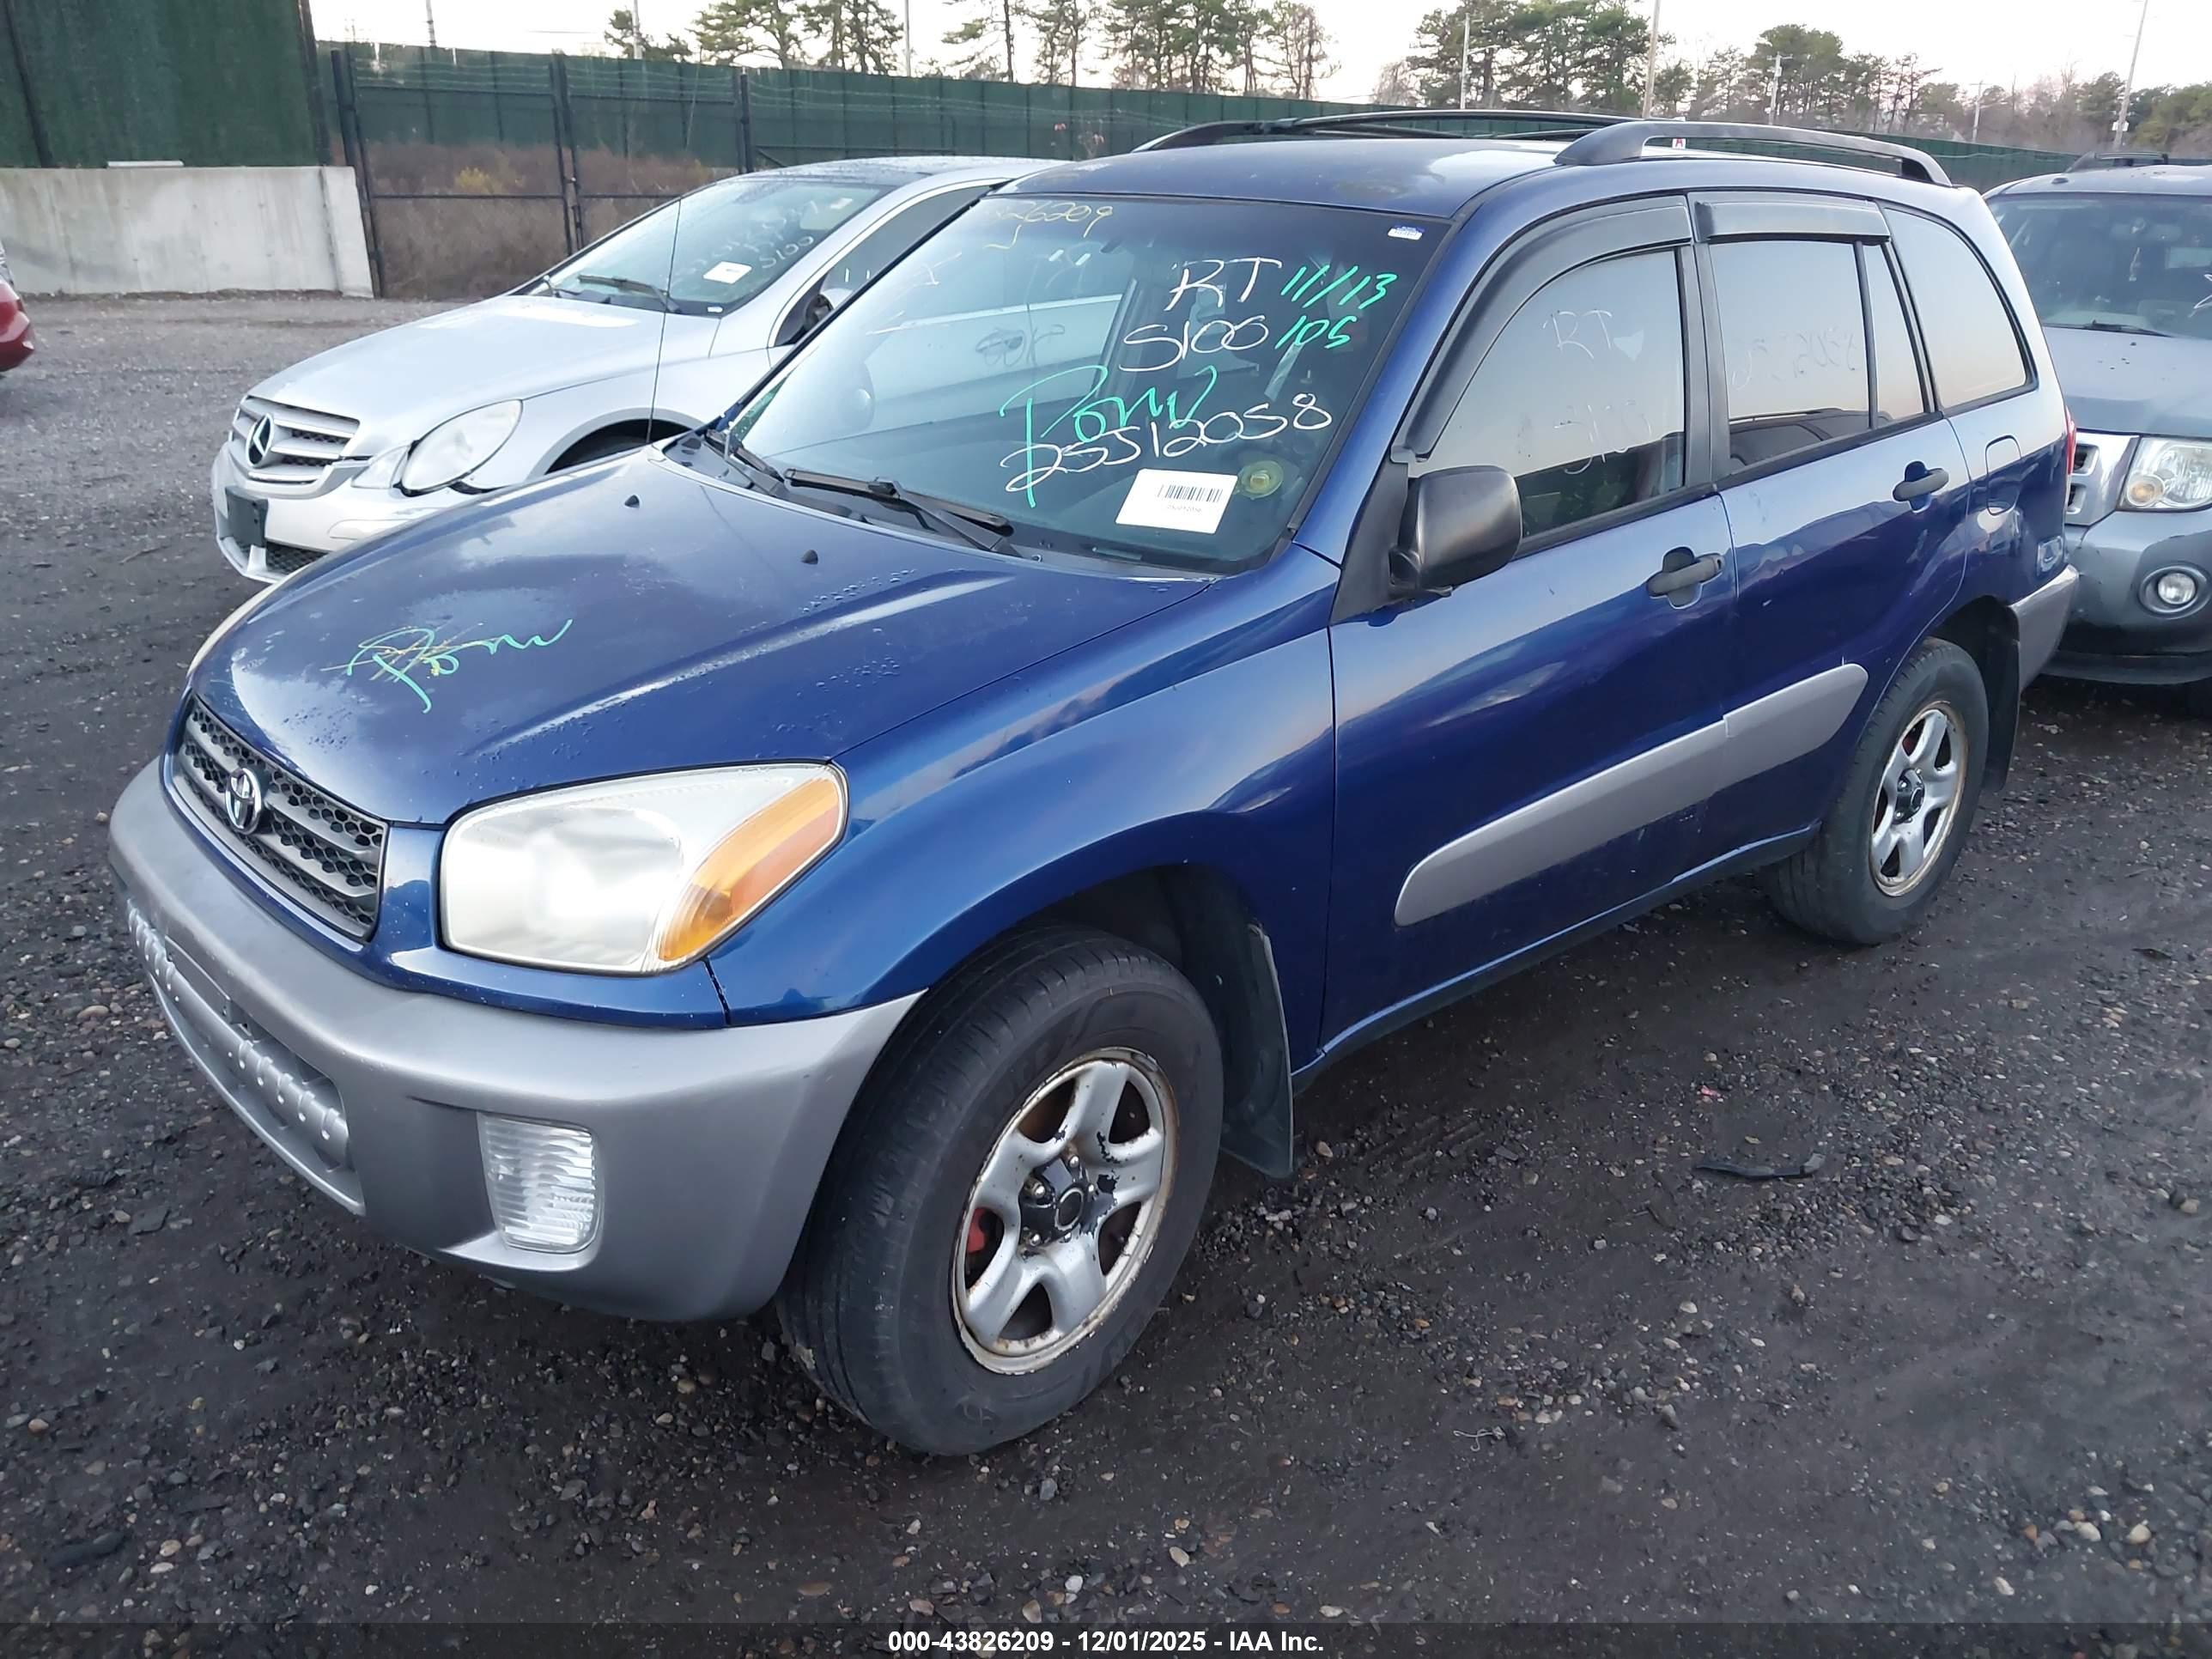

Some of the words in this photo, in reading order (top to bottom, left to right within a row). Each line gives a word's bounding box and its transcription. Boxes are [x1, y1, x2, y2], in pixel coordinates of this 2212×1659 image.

[1164, 257, 1282, 312] RT
[1280, 264, 1397, 310] 11/13
[1274, 315, 1357, 349] 105
